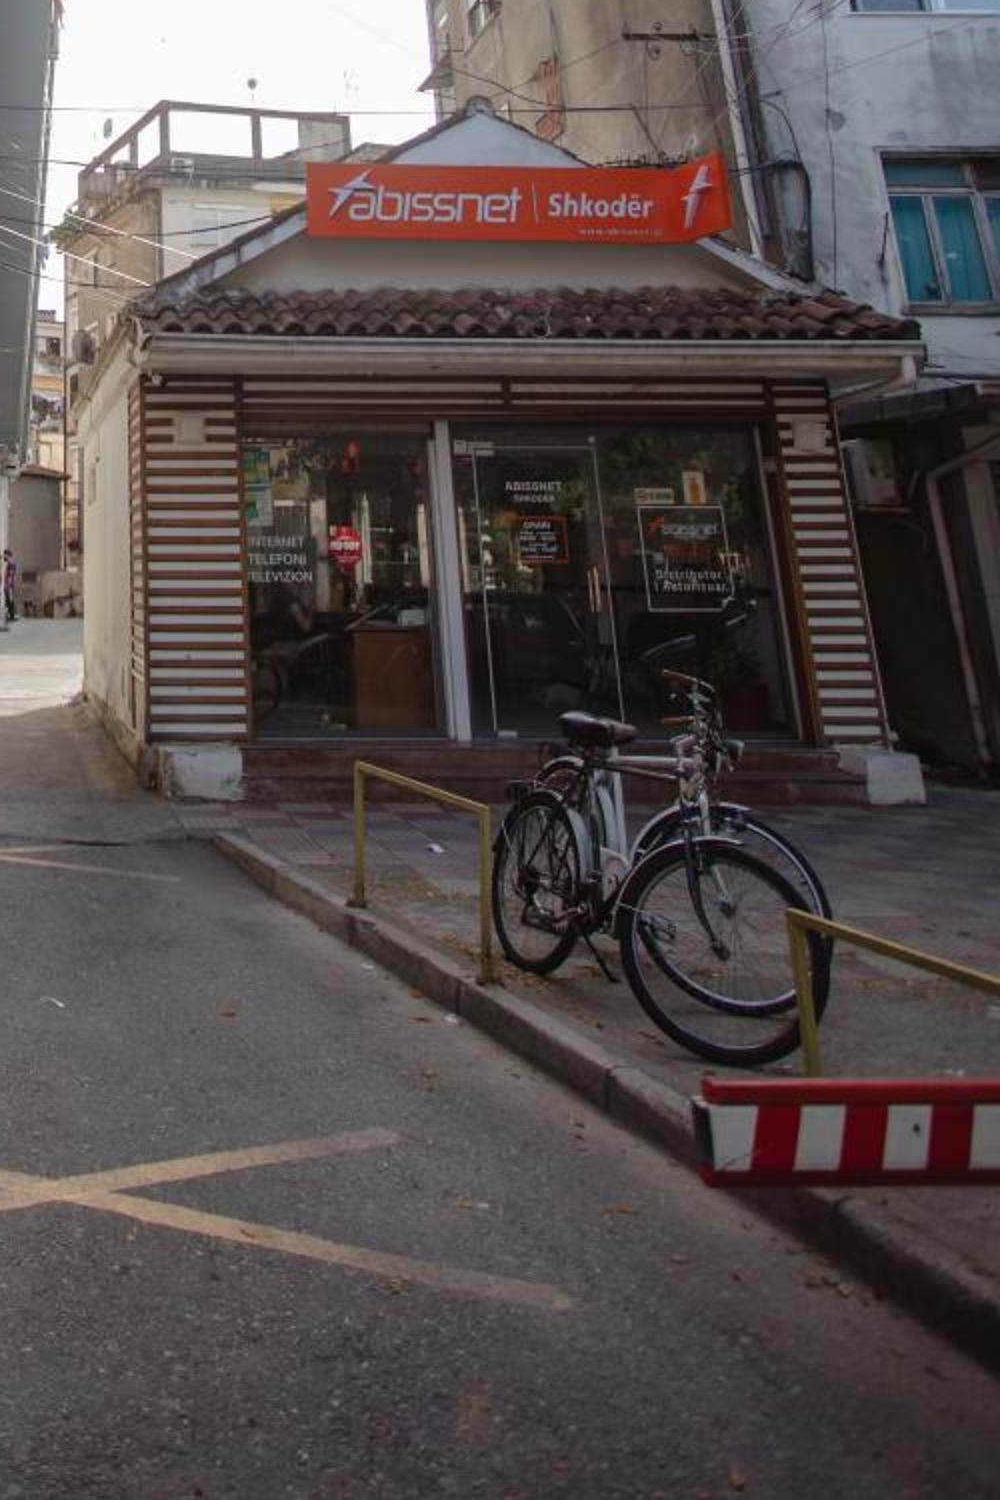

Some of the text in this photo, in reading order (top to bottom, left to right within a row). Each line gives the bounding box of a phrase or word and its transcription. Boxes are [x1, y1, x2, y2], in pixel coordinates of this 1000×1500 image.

[348, 183, 655, 224] abissnet Shkodër
[248, 553, 307, 565] TELEFONI
